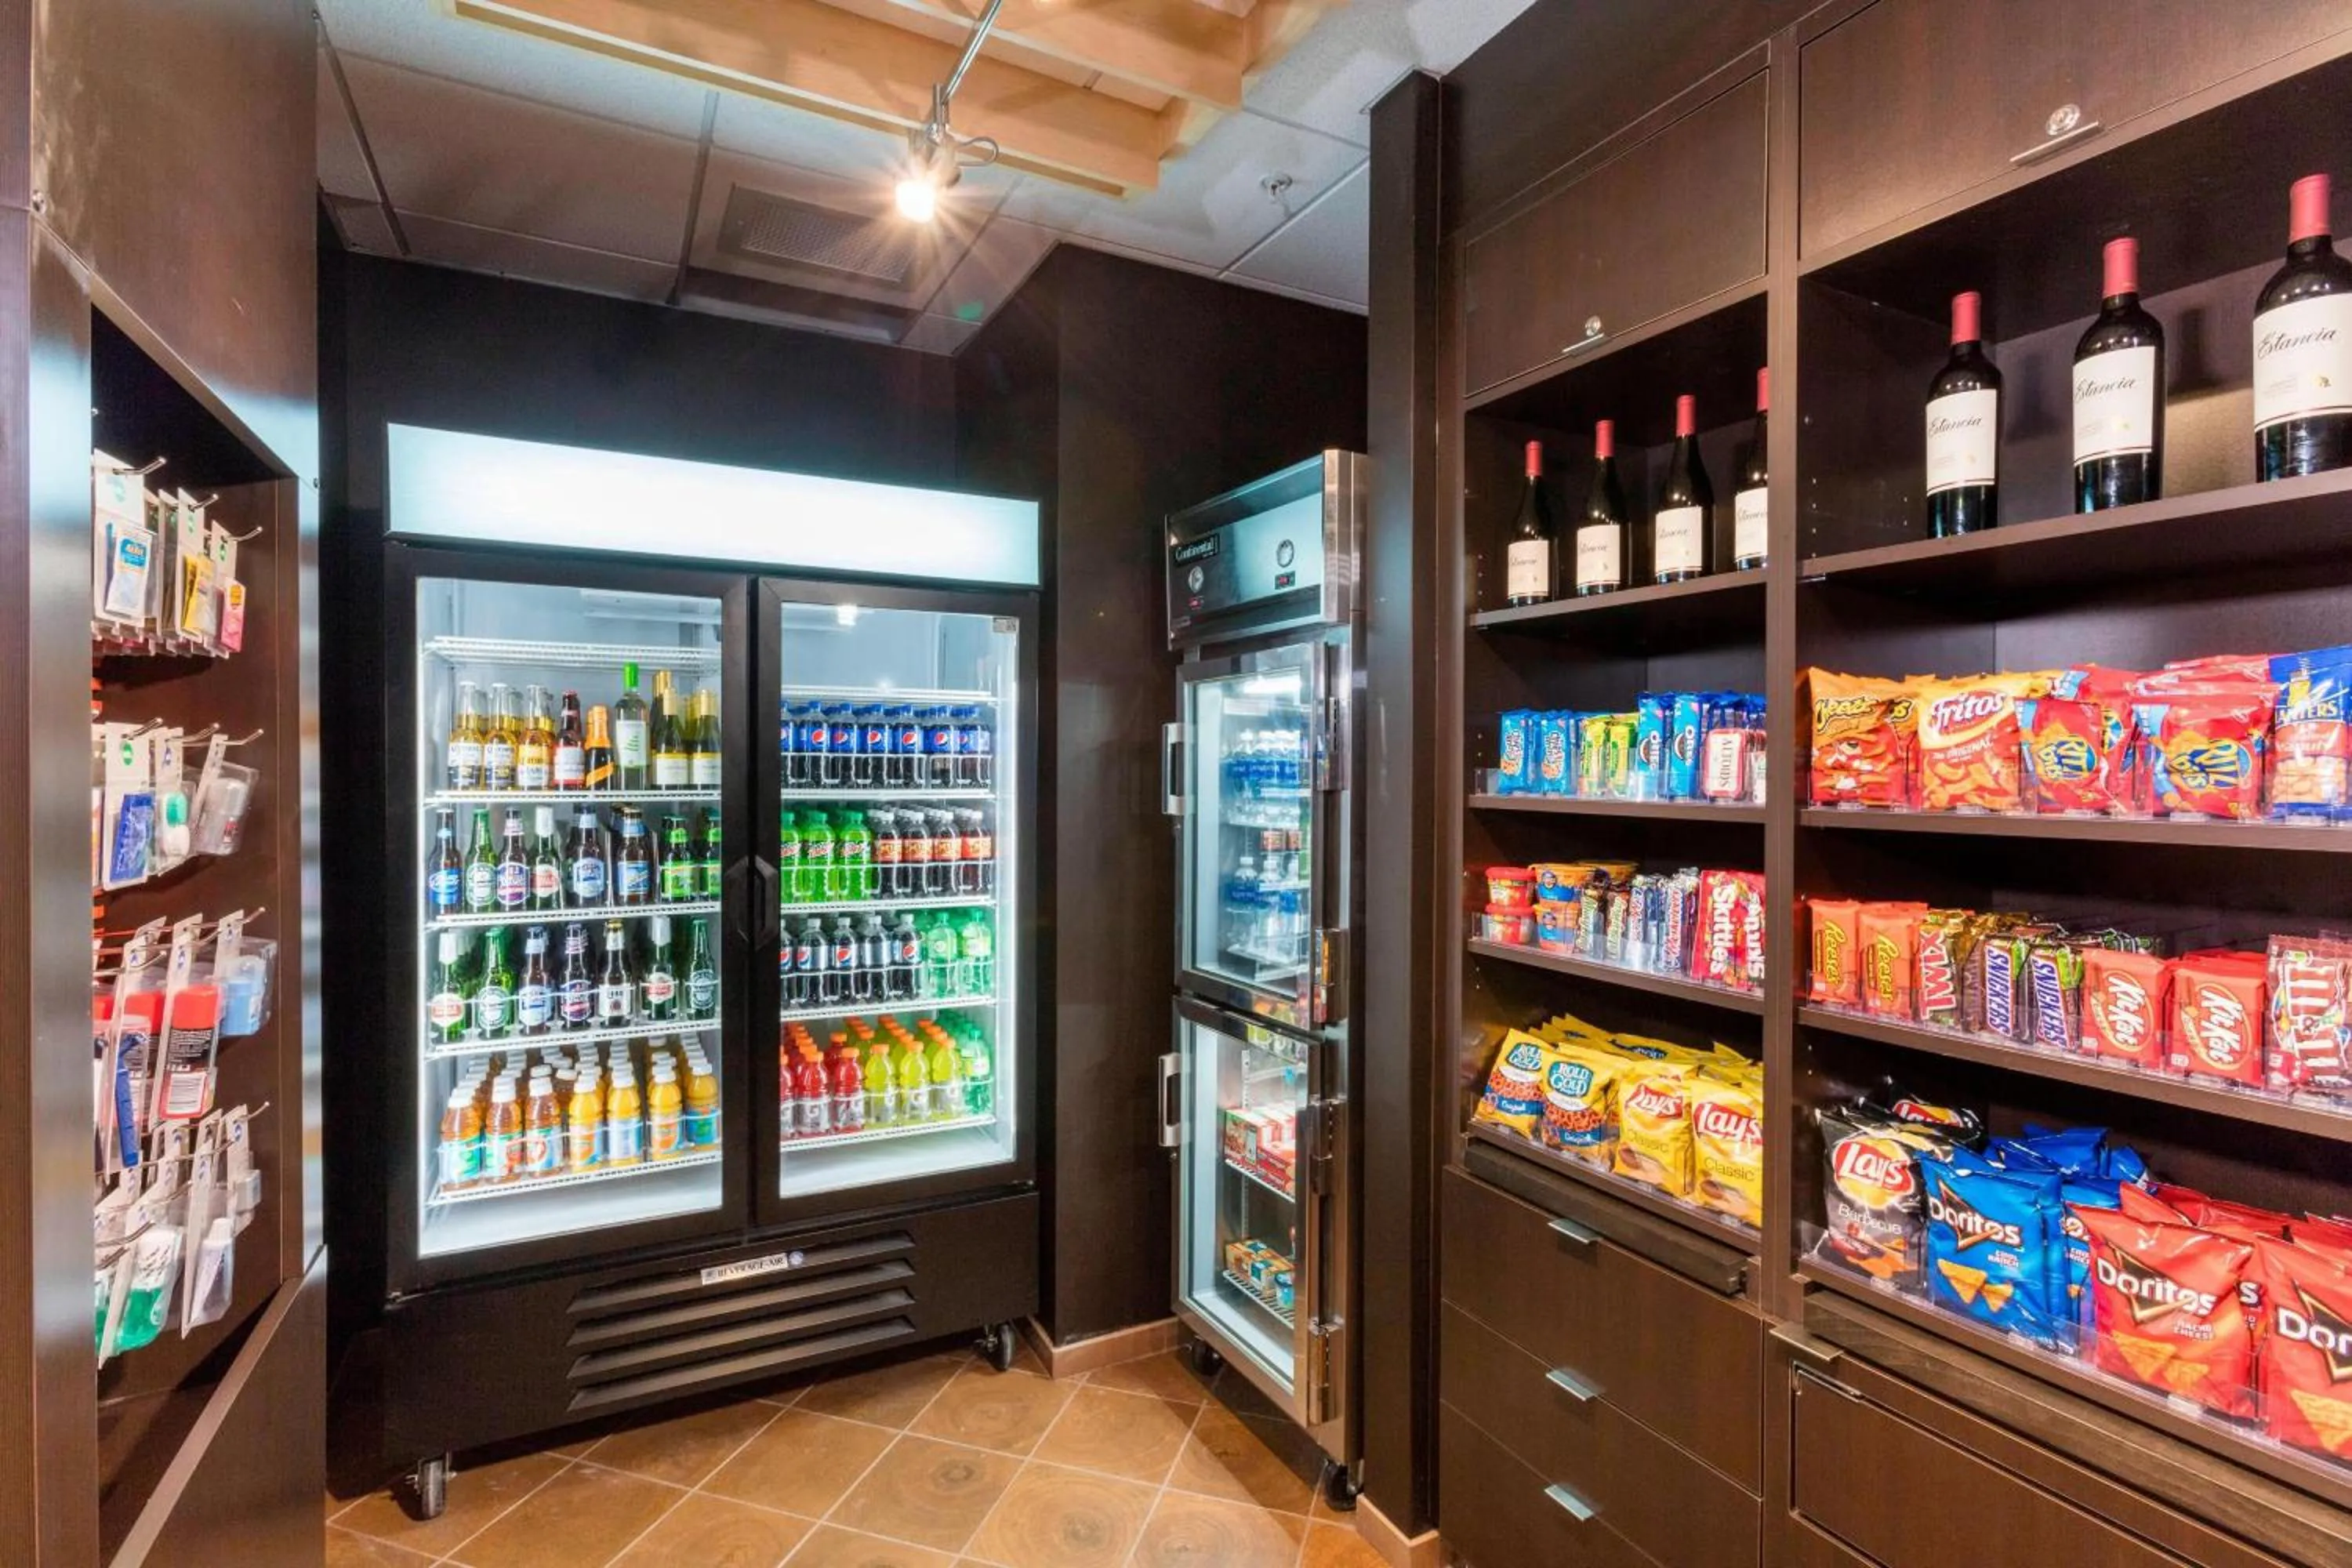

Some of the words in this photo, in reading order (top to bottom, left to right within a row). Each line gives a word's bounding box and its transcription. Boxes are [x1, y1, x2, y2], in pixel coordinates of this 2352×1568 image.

[2258, 326, 2339, 359] Estancia
[2074, 377, 2139, 402] Estancia
[1928, 414, 1983, 437] Estancia
[1932, 693, 2008, 732] Fritos
[1710, 883, 1737, 978] Skittles
[1920, 929, 1956, 1019] TWIX
[1985, 946, 2013, 1036] SNICKERS
[2031, 956, 2068, 1049] SNICKERS
[1551, 1073, 1587, 1095] GOLD
[1559, 1062, 1590, 1080] ROLD
[1628, 1129, 1669, 1152] Classic
[1704, 1156, 1755, 1181] Classic
[1838, 1203, 1903, 1235] Barbecue
[1929, 1197, 2020, 1245] Doritos
[2097, 1257, 2217, 1317] Doritos
